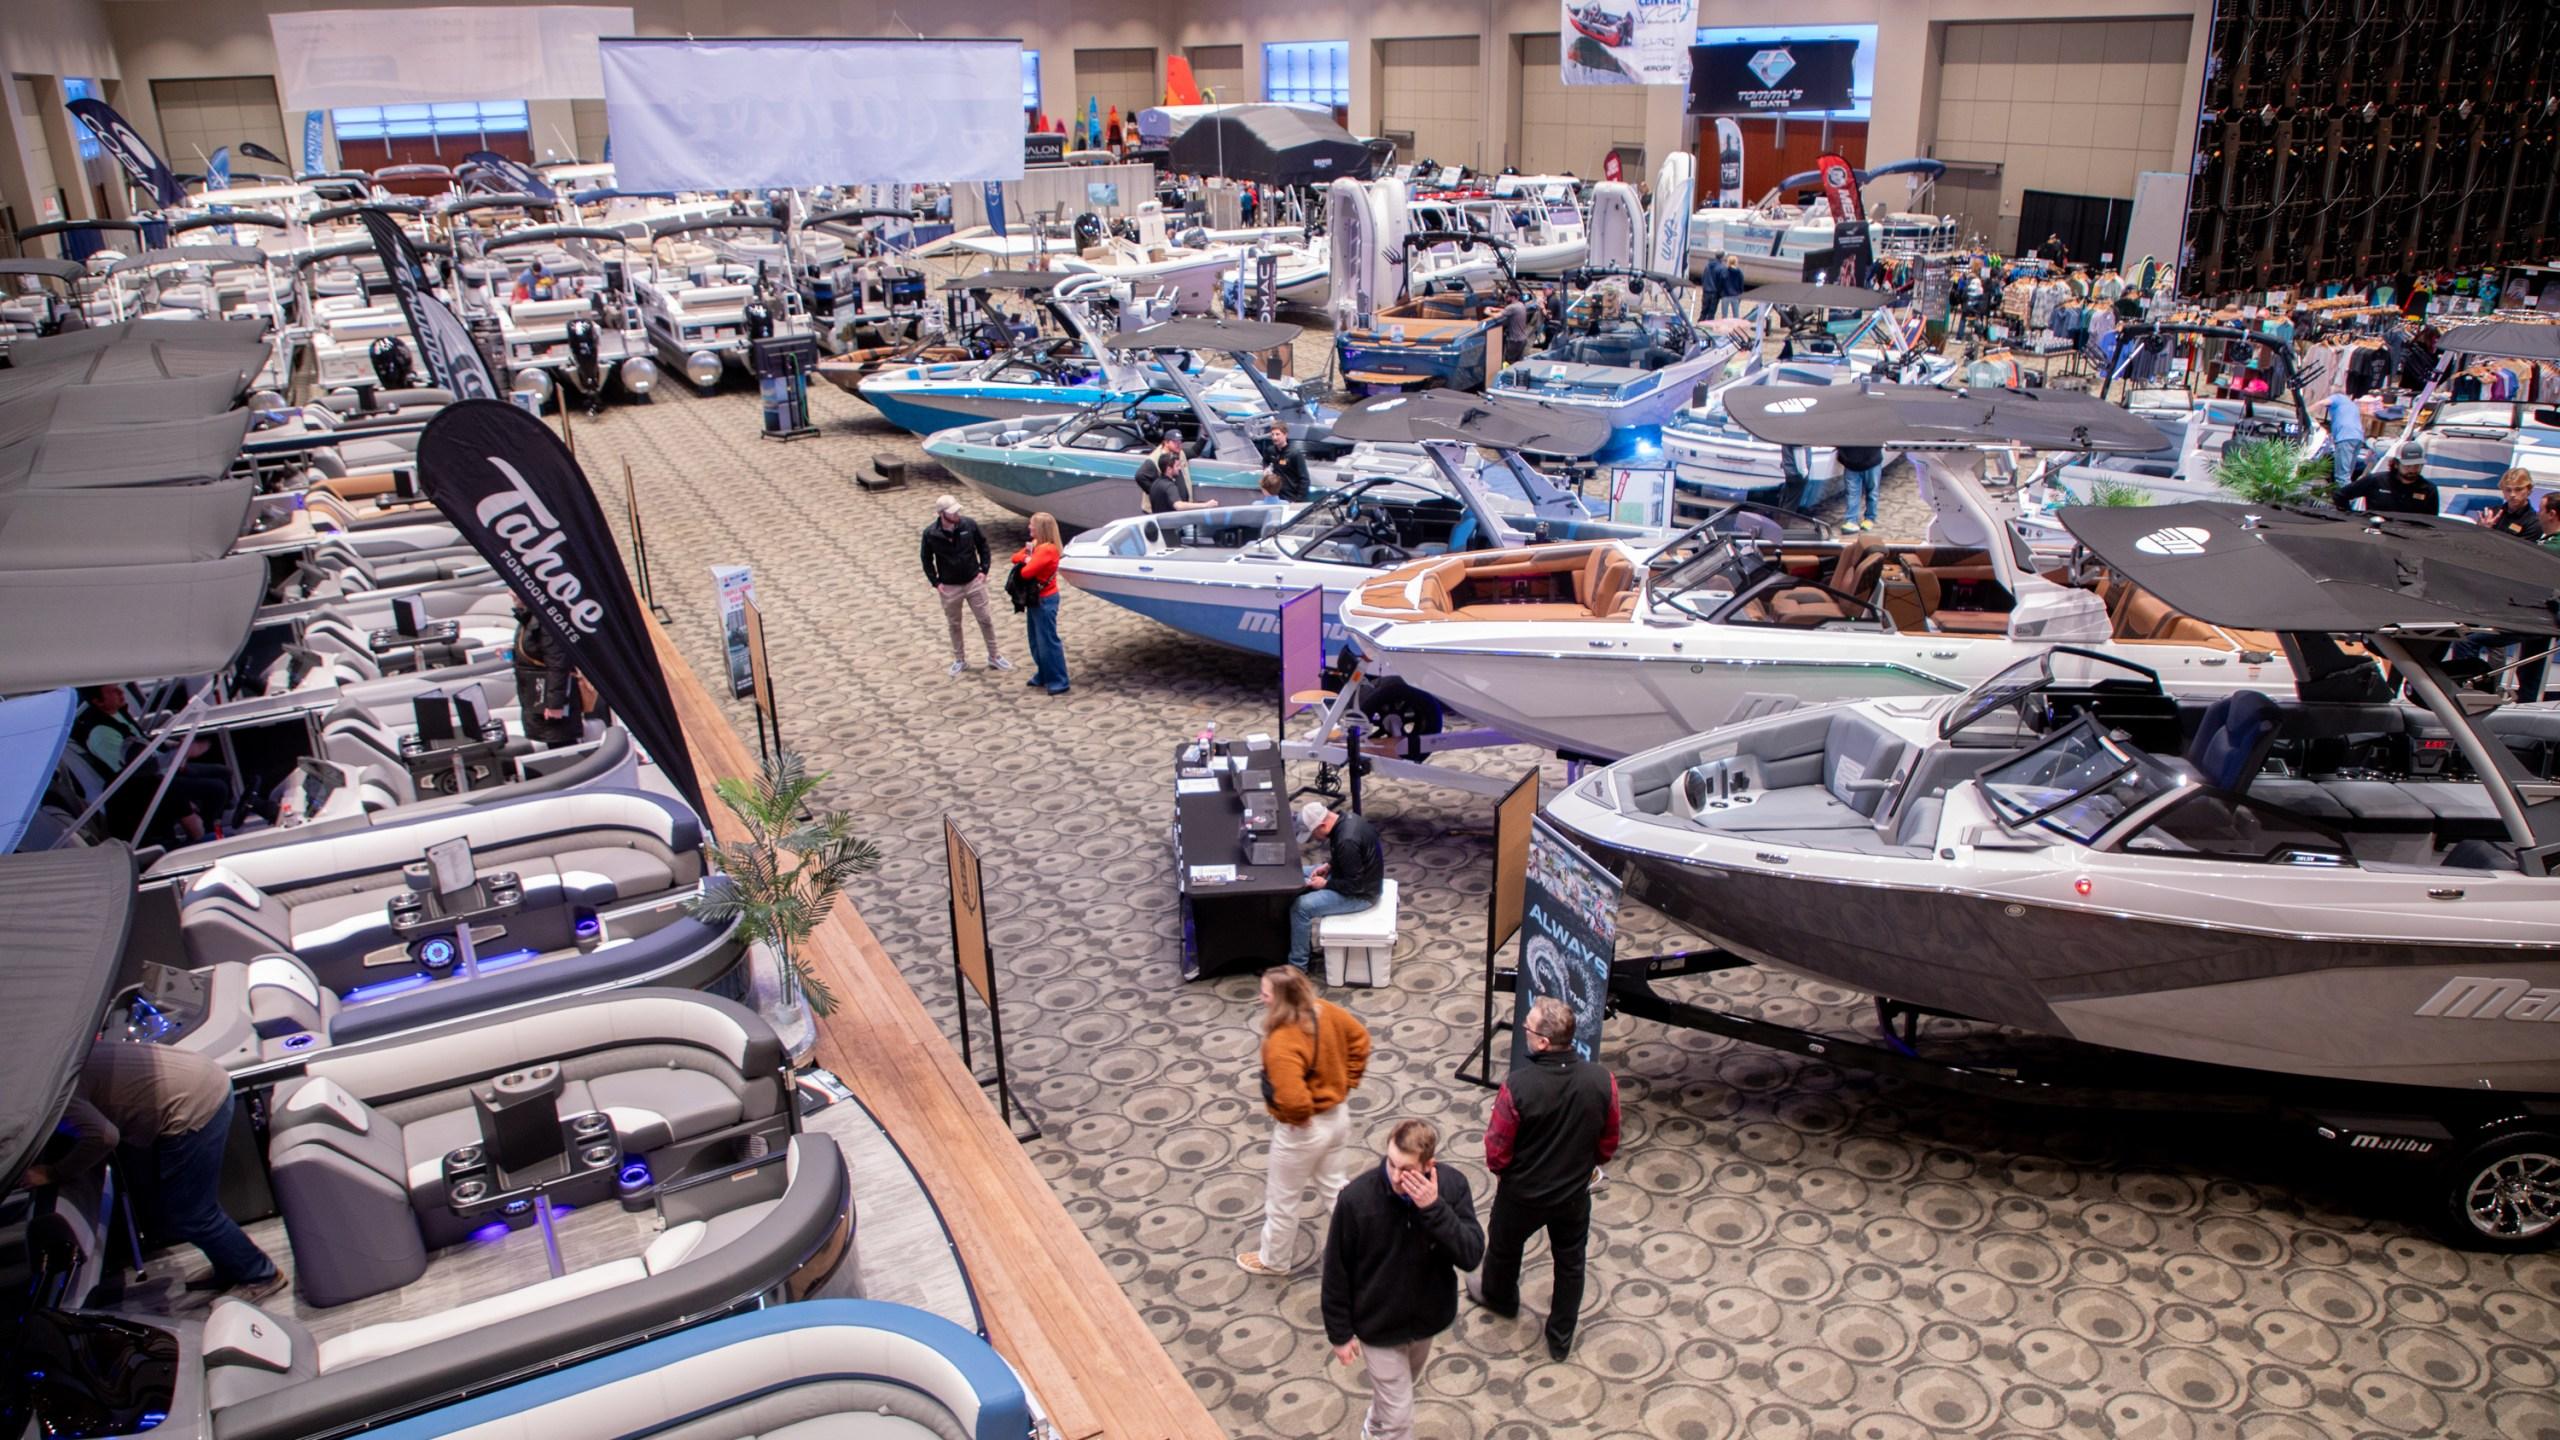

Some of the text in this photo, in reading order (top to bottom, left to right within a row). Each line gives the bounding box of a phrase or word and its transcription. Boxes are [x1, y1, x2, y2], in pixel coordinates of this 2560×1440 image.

[1738, 89, 1803, 101] TOMMY'S
[80, 113, 159, 201] COBIA
[476, 456, 604, 634] Tahoe
[500, 550, 580, 643] PONTOON BOATS
[1529, 904, 1608, 980] ALWAYS
[1569, 990, 1586, 1009] THE
[2351, 1134, 2433, 1153] Malibu
